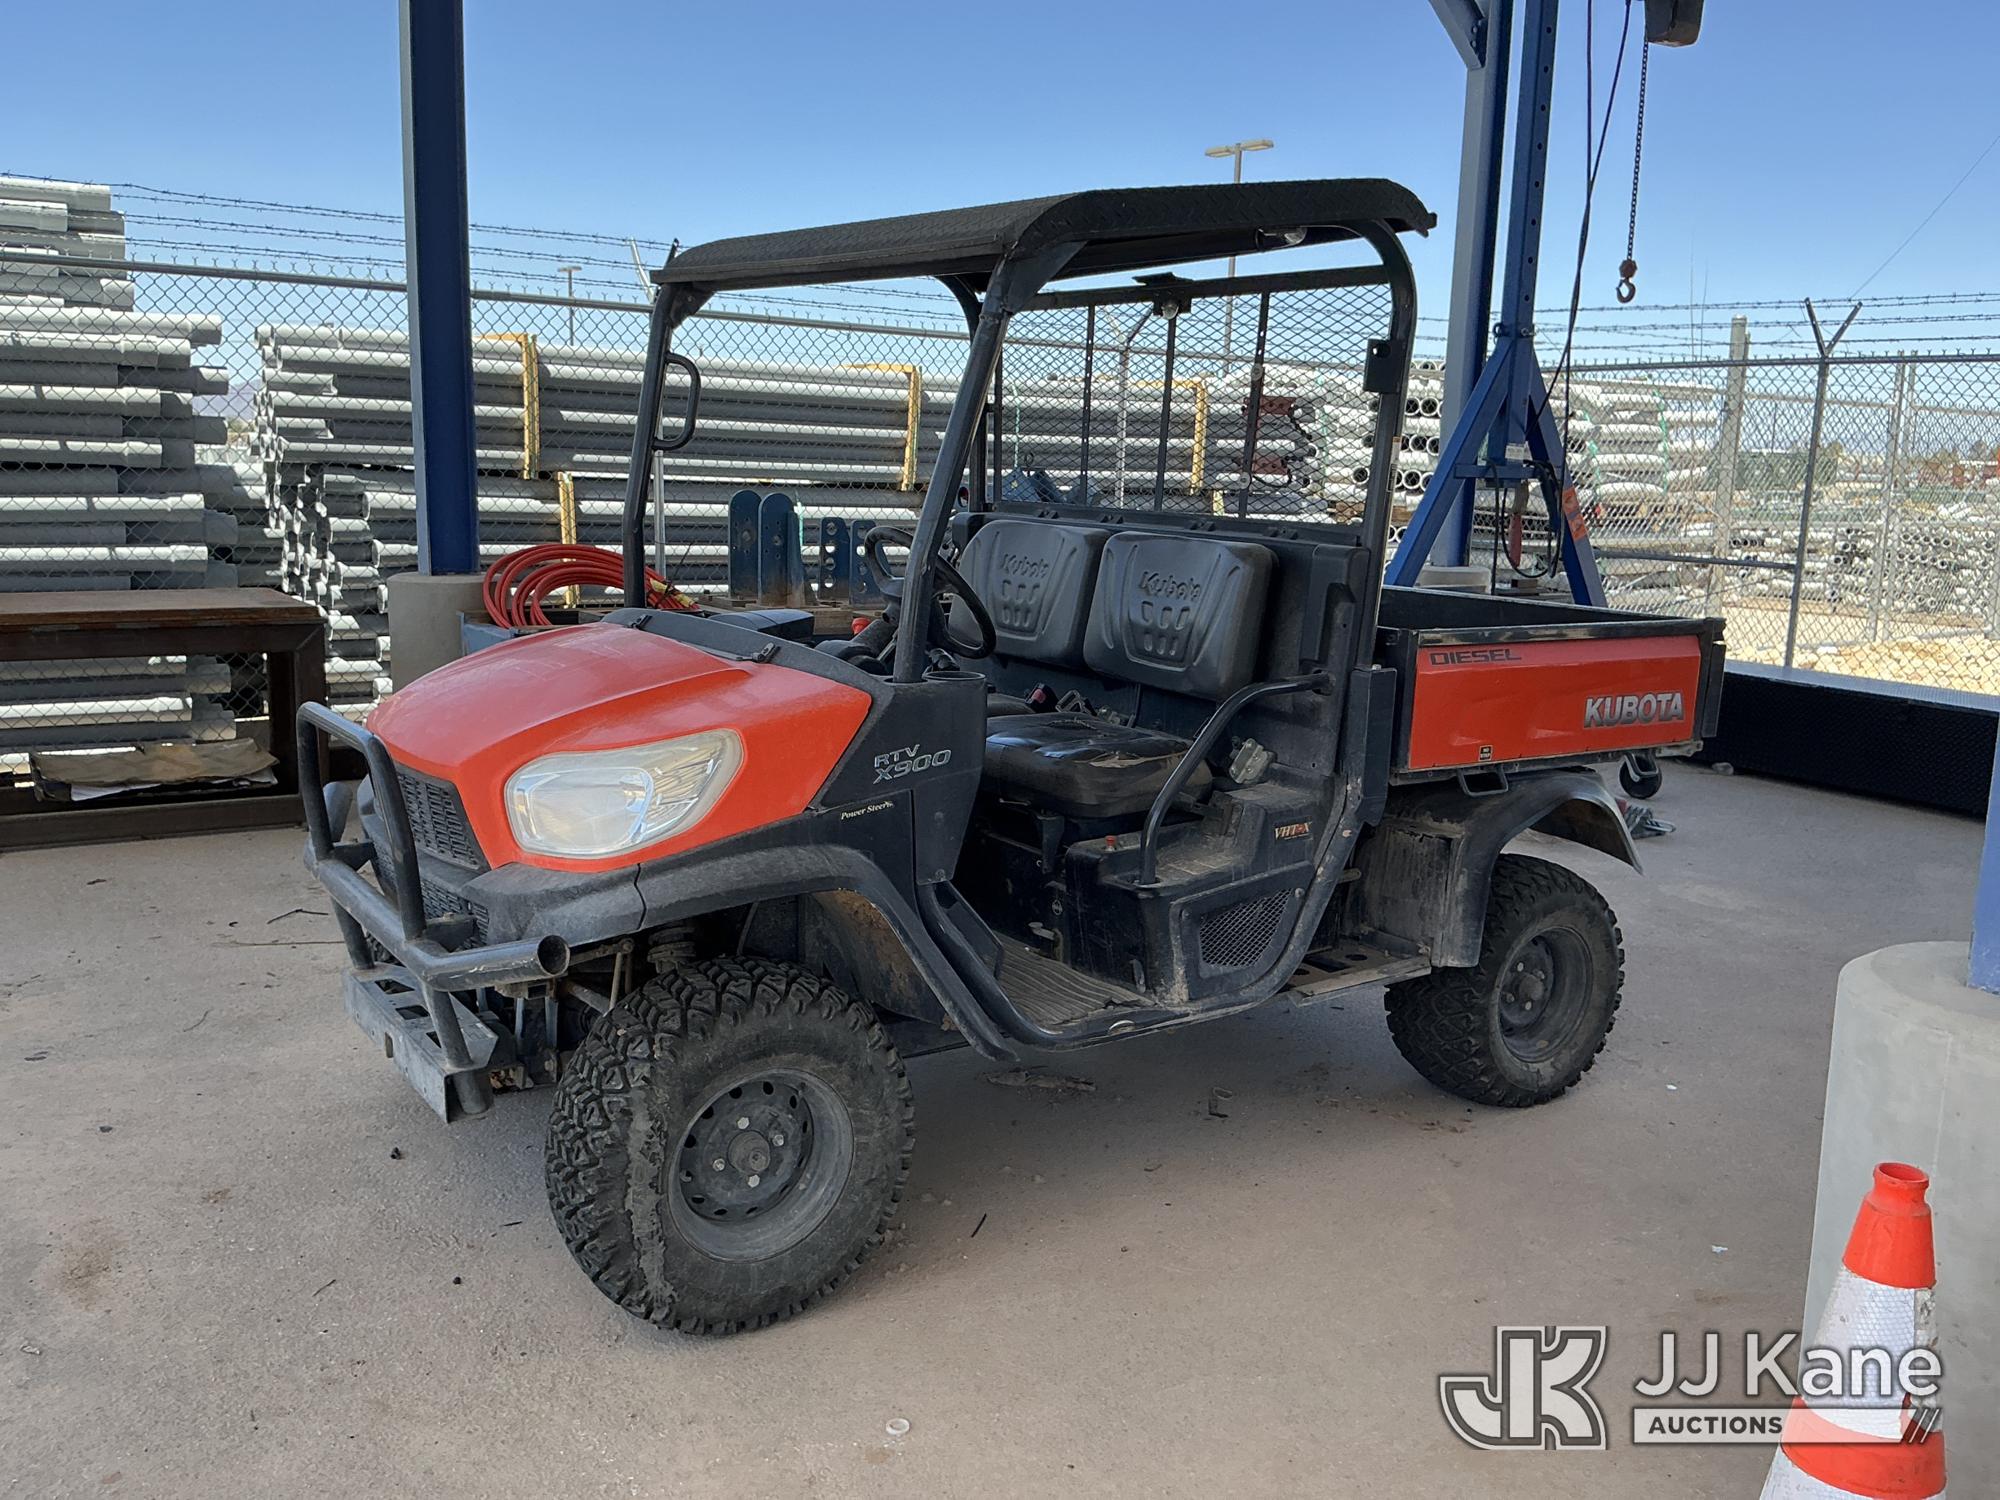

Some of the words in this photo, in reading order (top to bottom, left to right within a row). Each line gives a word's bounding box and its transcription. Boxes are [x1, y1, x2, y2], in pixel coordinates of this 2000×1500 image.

[1001, 553, 1050, 578] Kubota
[1139, 571, 1201, 601] Kubota
[1430, 649, 1522, 666] DIESEL
[1583, 691, 1685, 729] KUBOTA
[872, 749, 952, 785] X900
[874, 744, 920, 768] RTV
[841, 808, 866, 820] Power
